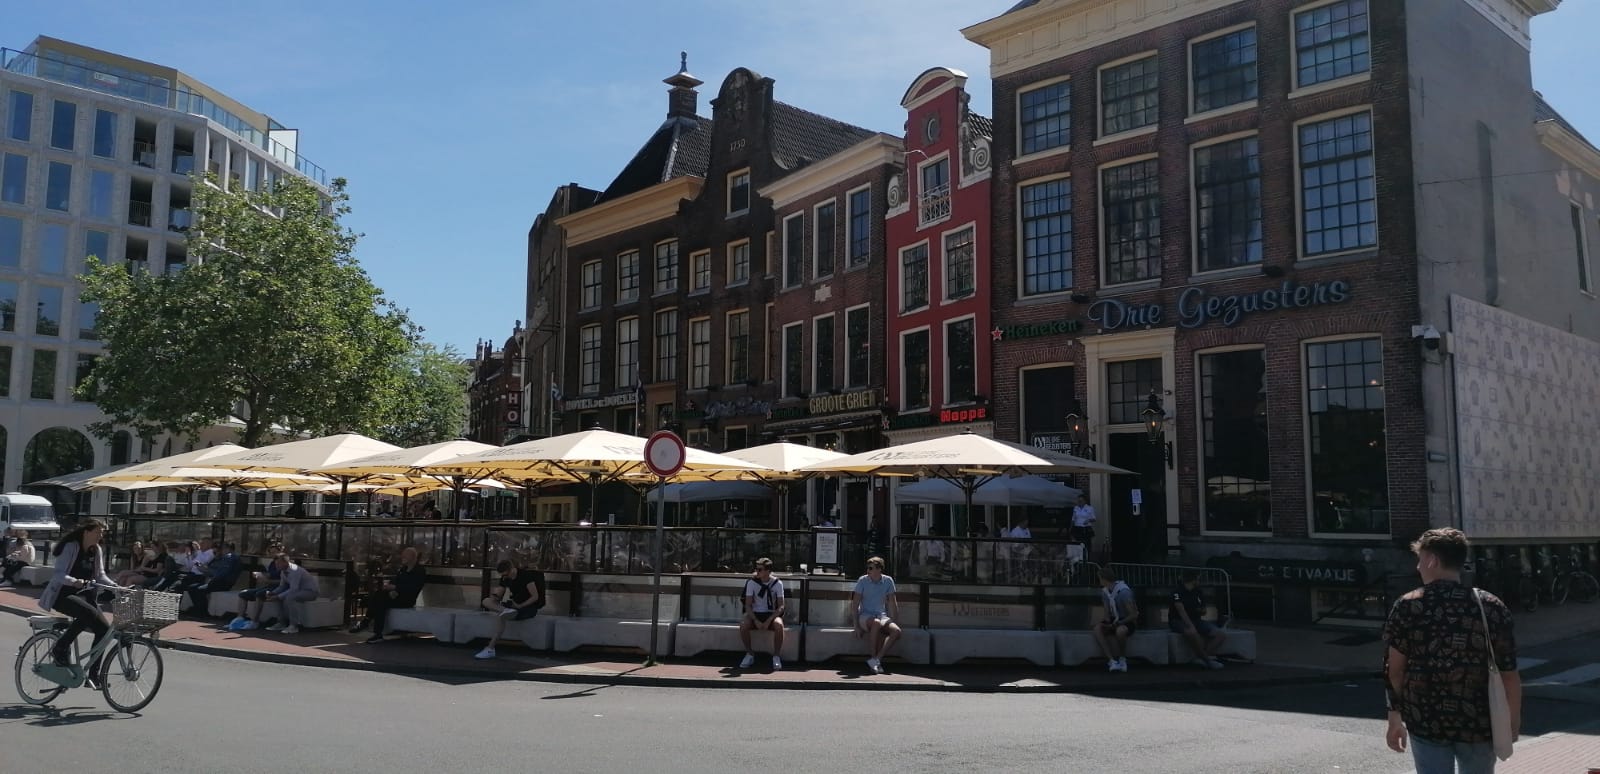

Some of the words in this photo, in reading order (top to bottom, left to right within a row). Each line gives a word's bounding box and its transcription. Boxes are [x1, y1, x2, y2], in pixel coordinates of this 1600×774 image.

[1087, 298, 1161, 329] Drie
[1177, 280, 1348, 328] Gezusters
[1006, 319, 1079, 338] Heineken
[809, 393, 844, 414] GROOTE
[846, 389, 874, 409] GRIET
